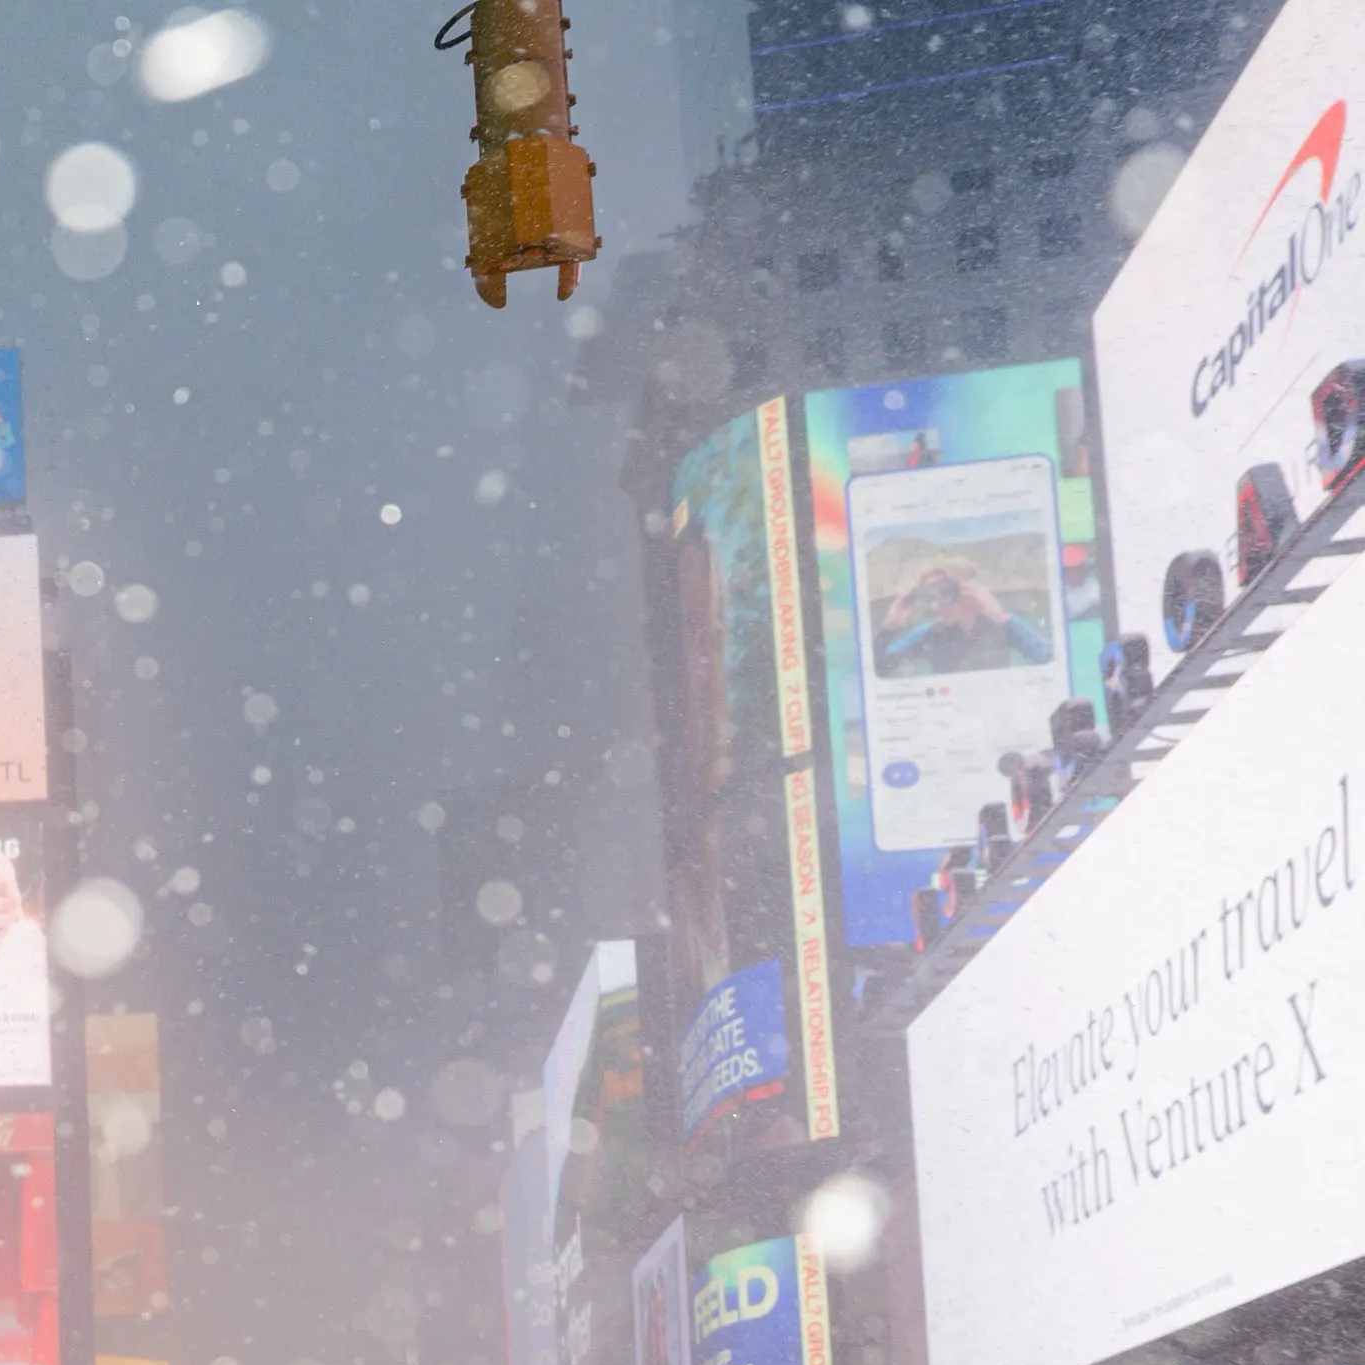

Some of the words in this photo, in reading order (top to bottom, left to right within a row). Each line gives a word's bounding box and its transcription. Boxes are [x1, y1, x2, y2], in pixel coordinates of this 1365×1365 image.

[803, 936, 830, 1097] RELATIONSHIP
[1011, 1006, 1115, 1138] Elevate
[1124, 928, 1208, 1082] your
[1218, 773, 1356, 982] travel
[1040, 1125, 1115, 1239] with
[1119, 1041, 1276, 1188] Venture
[1287, 979, 1328, 1096] X
